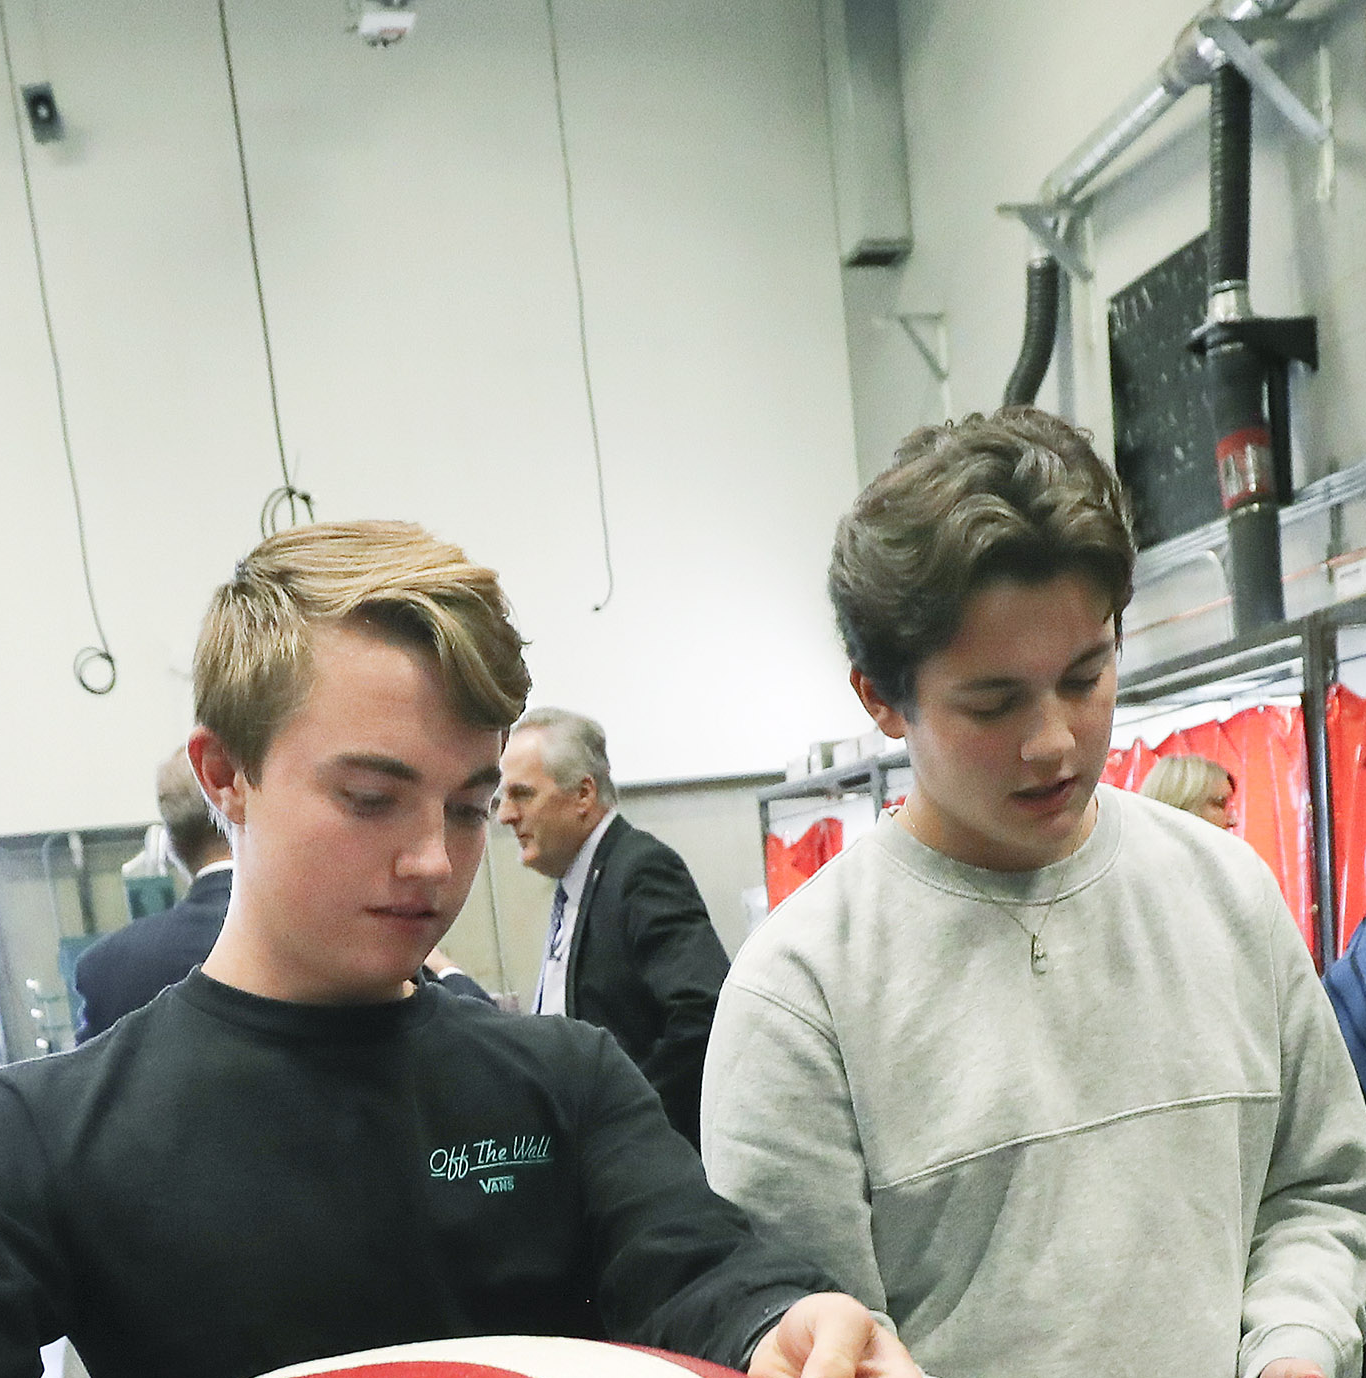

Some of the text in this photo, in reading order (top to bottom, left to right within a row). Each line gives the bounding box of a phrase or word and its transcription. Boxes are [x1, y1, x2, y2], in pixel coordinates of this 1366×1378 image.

[430, 1135, 552, 1181] Off The Wall
[479, 1175, 515, 1195] VANS
